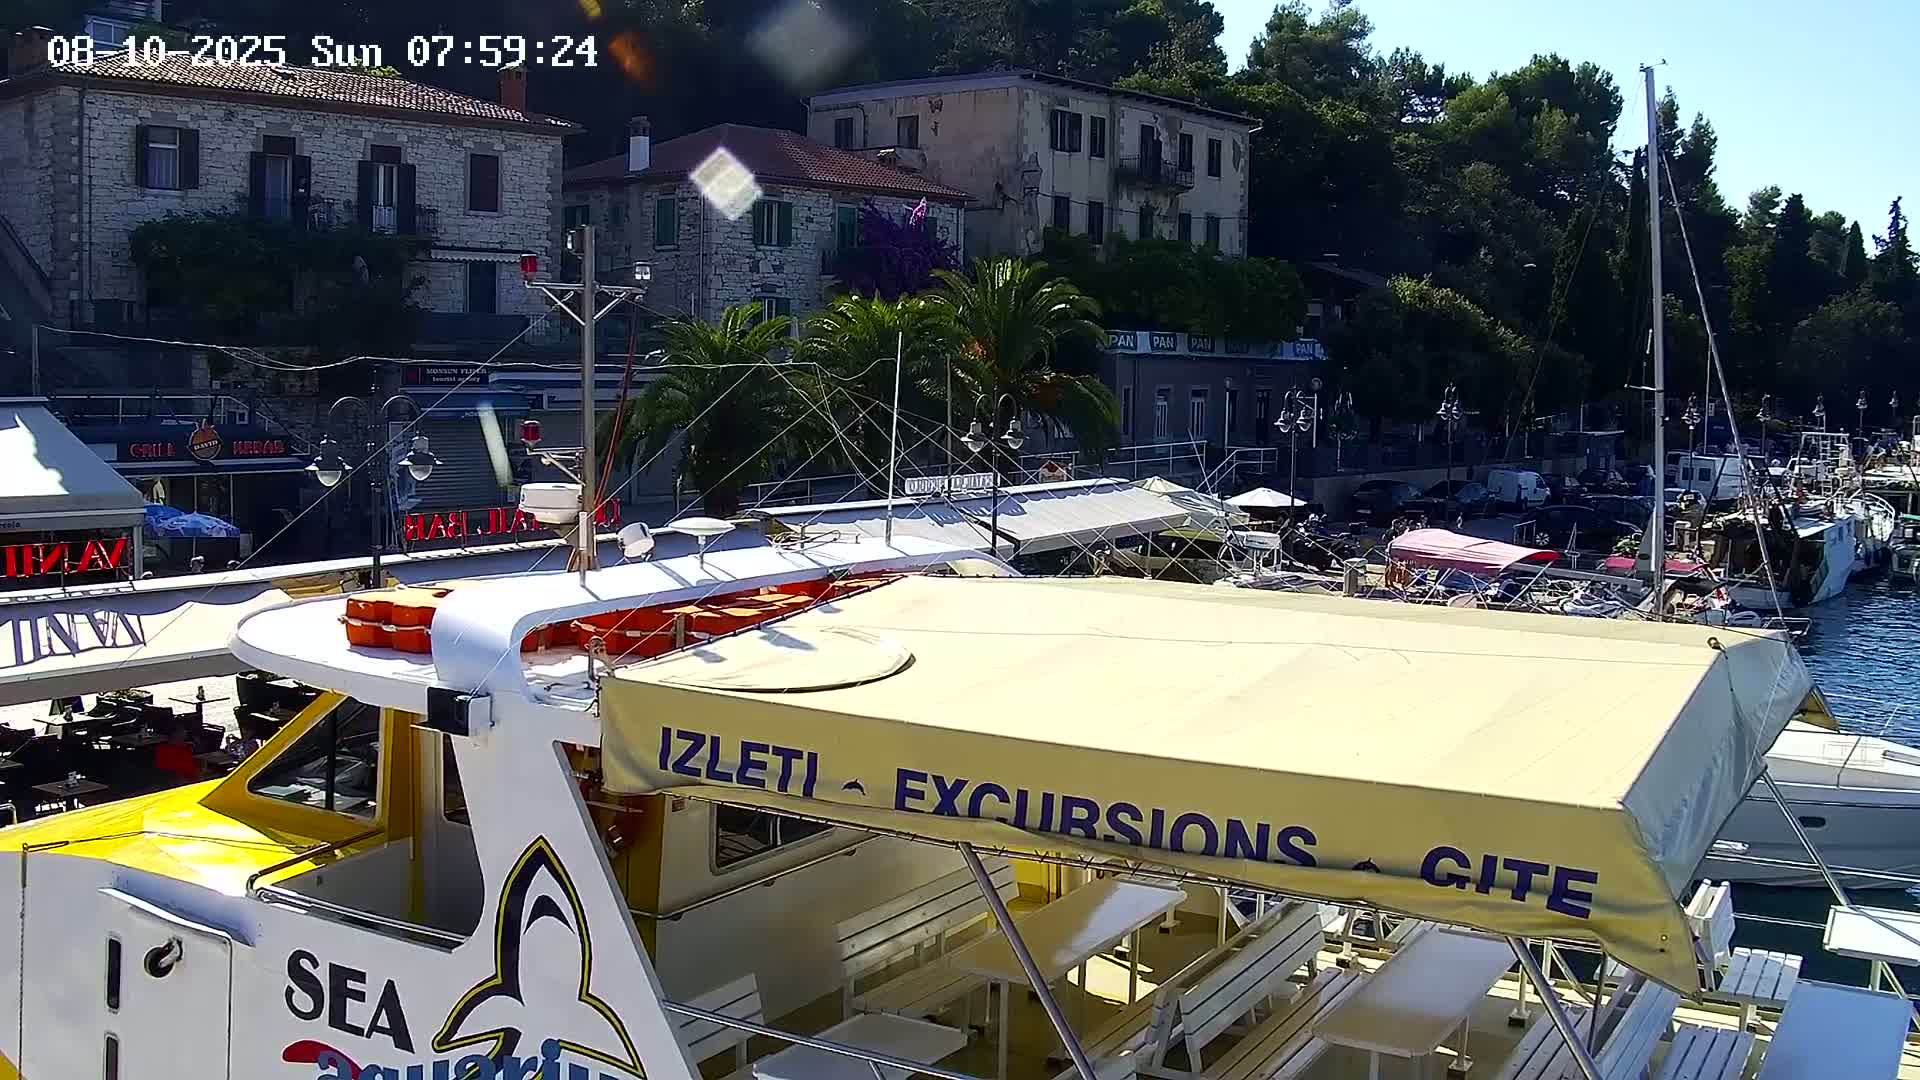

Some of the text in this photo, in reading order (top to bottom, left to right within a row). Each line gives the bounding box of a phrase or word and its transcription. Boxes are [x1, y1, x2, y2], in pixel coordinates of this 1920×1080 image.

[1109, 333, 1136, 348] PAN
[1152, 335, 1176, 350] PAN
[1190, 337, 1214, 351] PAN
[128, 438, 287, 458] GRILL DAVID KEBAB
[658, 726, 1600, 920] IZLETI EXCURSIONS GITE
[285, 949, 416, 1054] SEA
